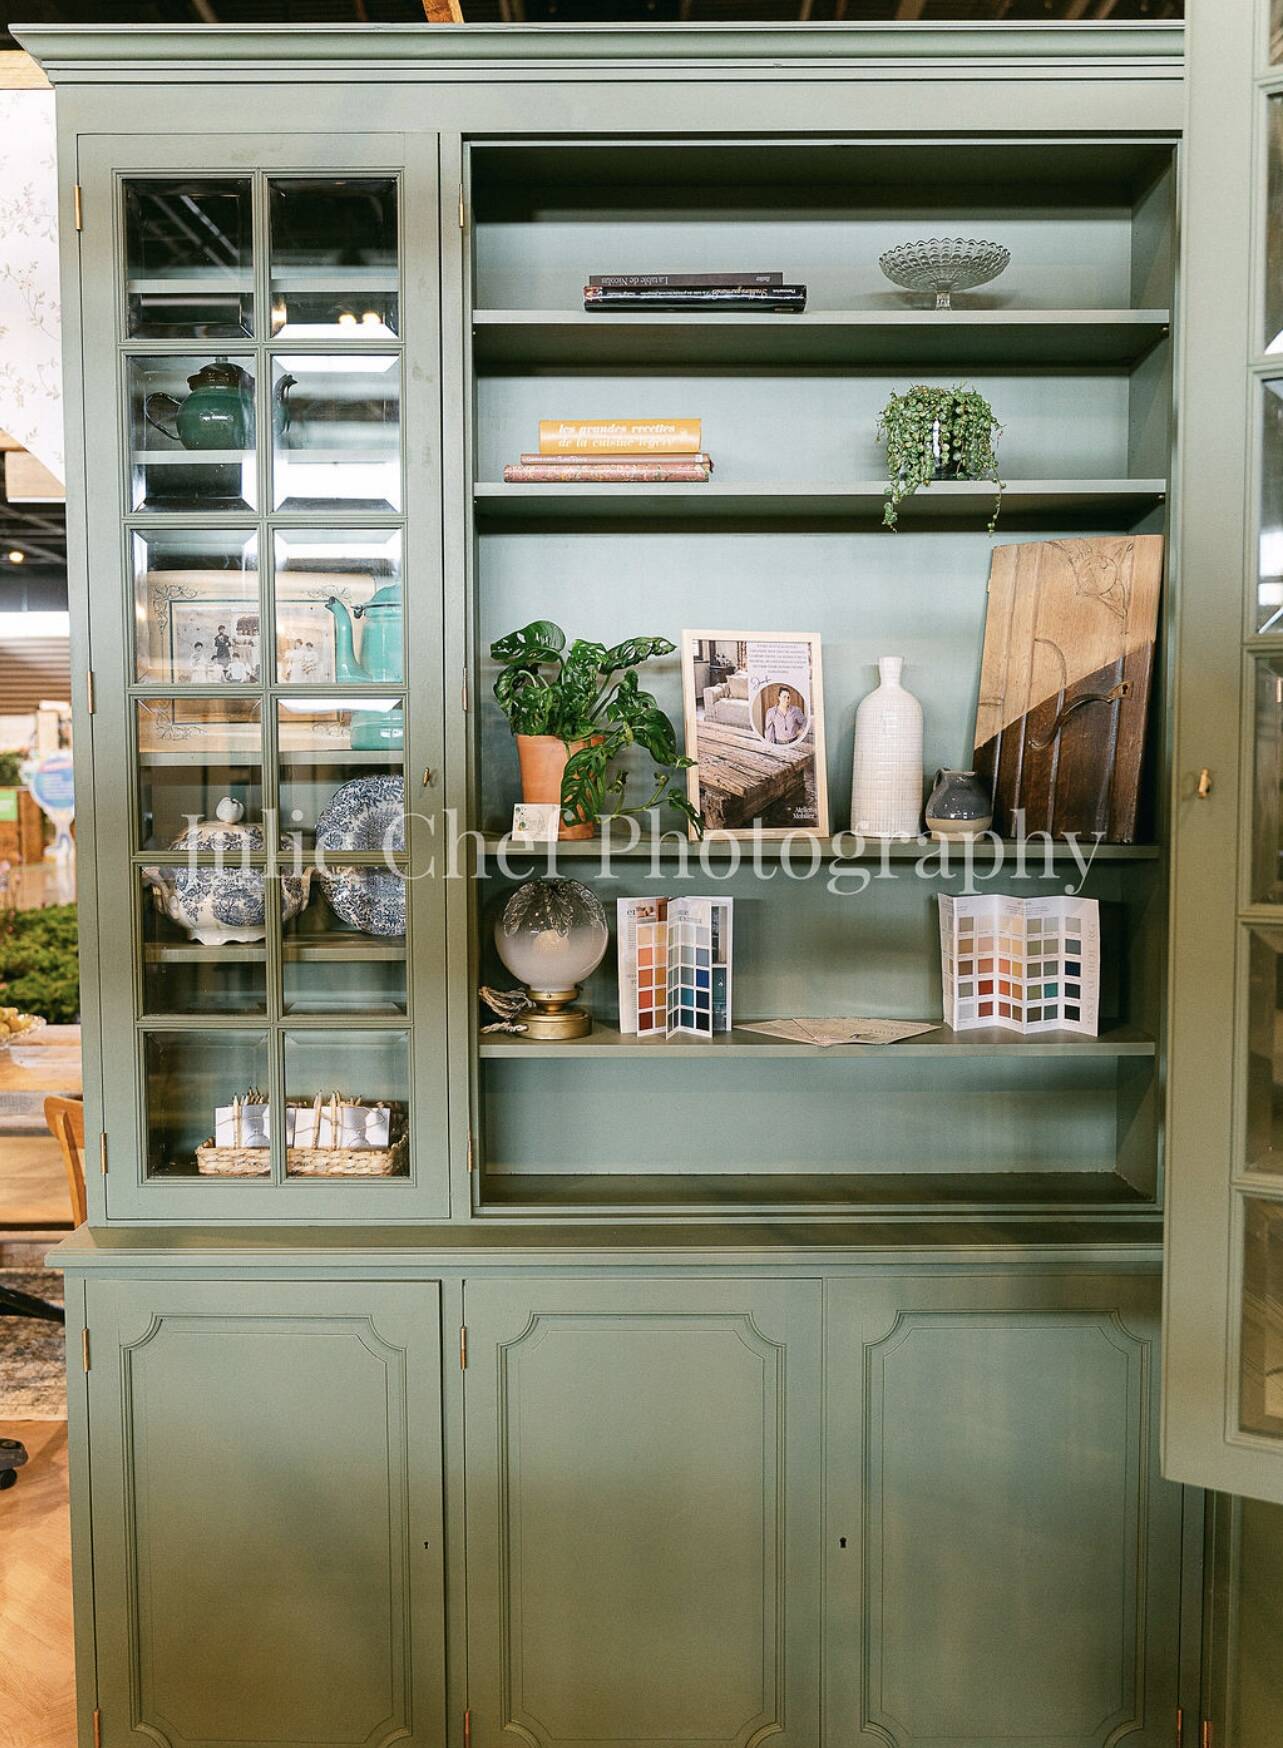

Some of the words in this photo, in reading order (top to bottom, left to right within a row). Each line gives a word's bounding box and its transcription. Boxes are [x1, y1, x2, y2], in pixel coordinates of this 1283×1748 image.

[558, 424, 575, 434] les
[580, 424, 627, 436] grandes
[631, 424, 676, 435] recettes
